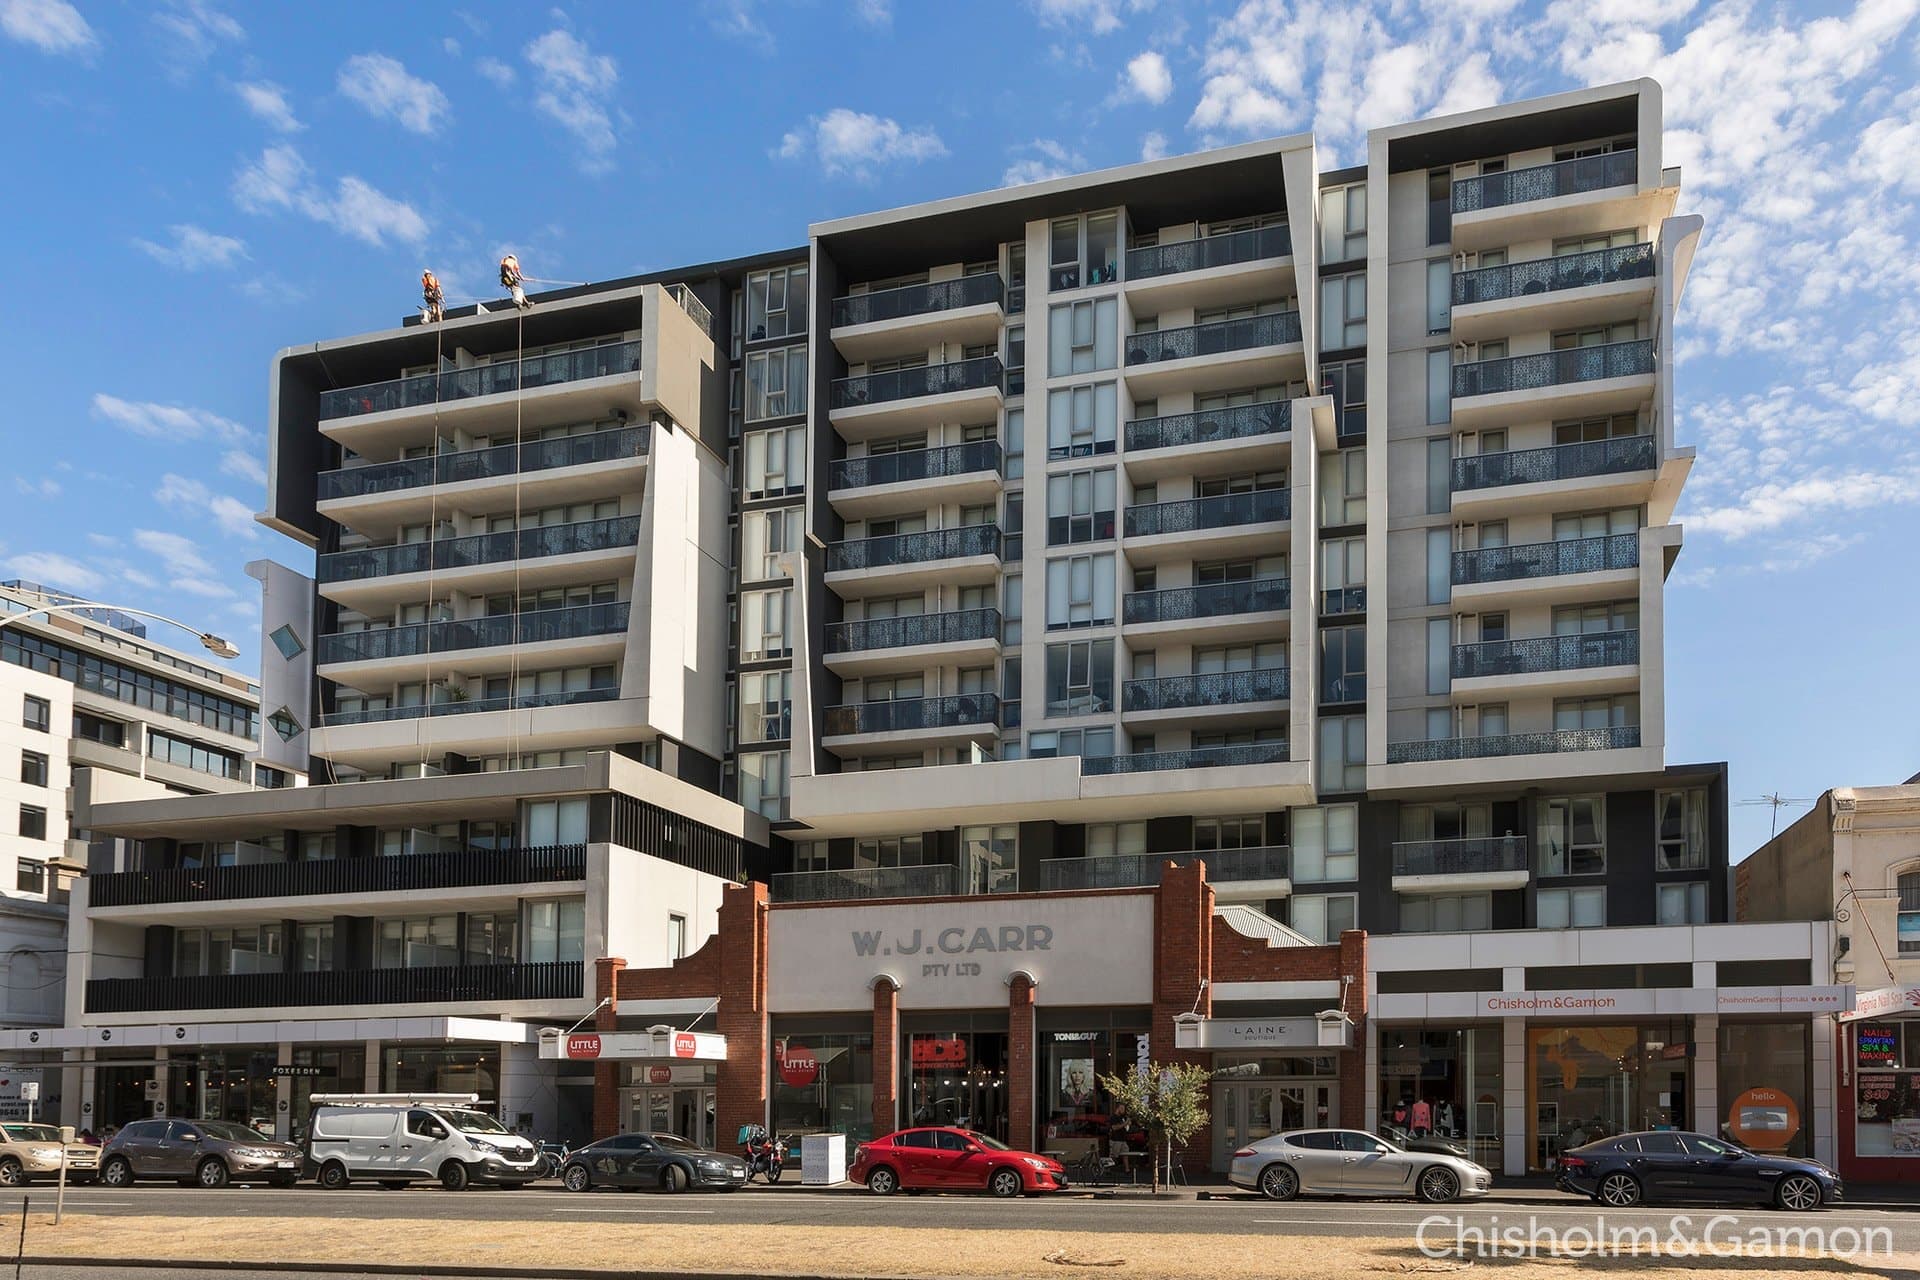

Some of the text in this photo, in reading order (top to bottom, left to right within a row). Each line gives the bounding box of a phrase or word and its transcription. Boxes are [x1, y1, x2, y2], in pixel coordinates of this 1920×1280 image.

[922, 963, 981, 977] PTY LTD
[1487, 996, 1616, 1011] Chisholm&Gamon
[1234, 1026, 1287, 1035] LAINE
[1863, 1028, 1892, 1037] NAILS
[570, 1040, 598, 1050] LITTLE
[676, 1041, 696, 1050] LITTLE
[1861, 1044, 1880, 1052] SPA
[784, 1059, 815, 1069] LITTLE
[303, 1067, 321, 1075] DEN
[1751, 1092, 1776, 1101] hello
